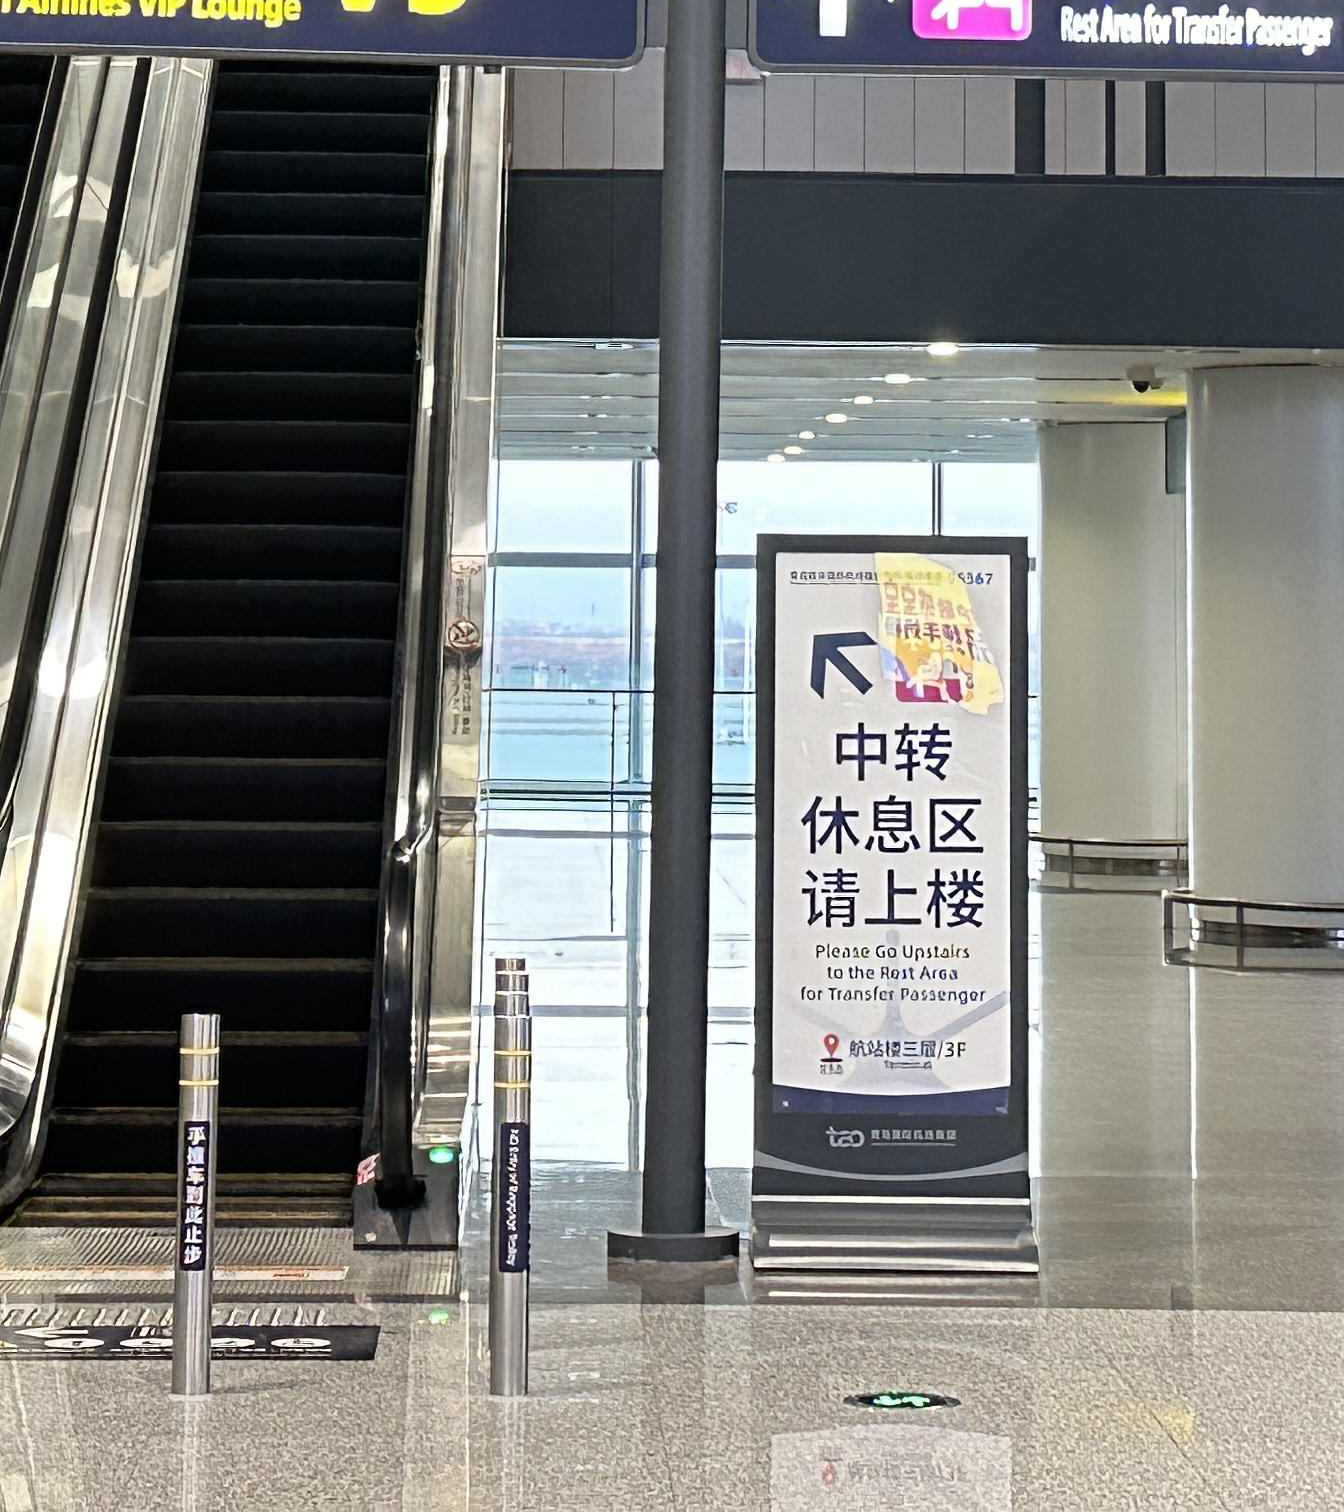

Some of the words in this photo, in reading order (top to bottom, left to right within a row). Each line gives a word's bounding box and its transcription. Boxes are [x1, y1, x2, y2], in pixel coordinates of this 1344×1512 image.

[1061, 5, 1099, 43] Rest
[1100, 4, 1142, 44] Area
[1144, 3, 1171, 44] for
[1172, 4, 1244, 45] Transfer
[1245, 7, 1333, 56] Passenger
[836, 722, 953, 782] 中转
[801, 794, 985, 855] 休息区
[801, 868, 985, 928] 请上楼
[815, 943, 871, 959] Please
[875, 944, 897, 959] Go
[902, 943, 970, 962] Upstairs
[827, 966, 843, 980] to
[848, 965, 875, 980] the
[880, 966, 915, 980] Rest
[919, 965, 959, 981] Area
[800, 986, 824, 1001] for
[828, 986, 895, 1001] Transfer
[900, 987, 986, 1005] Passenger
